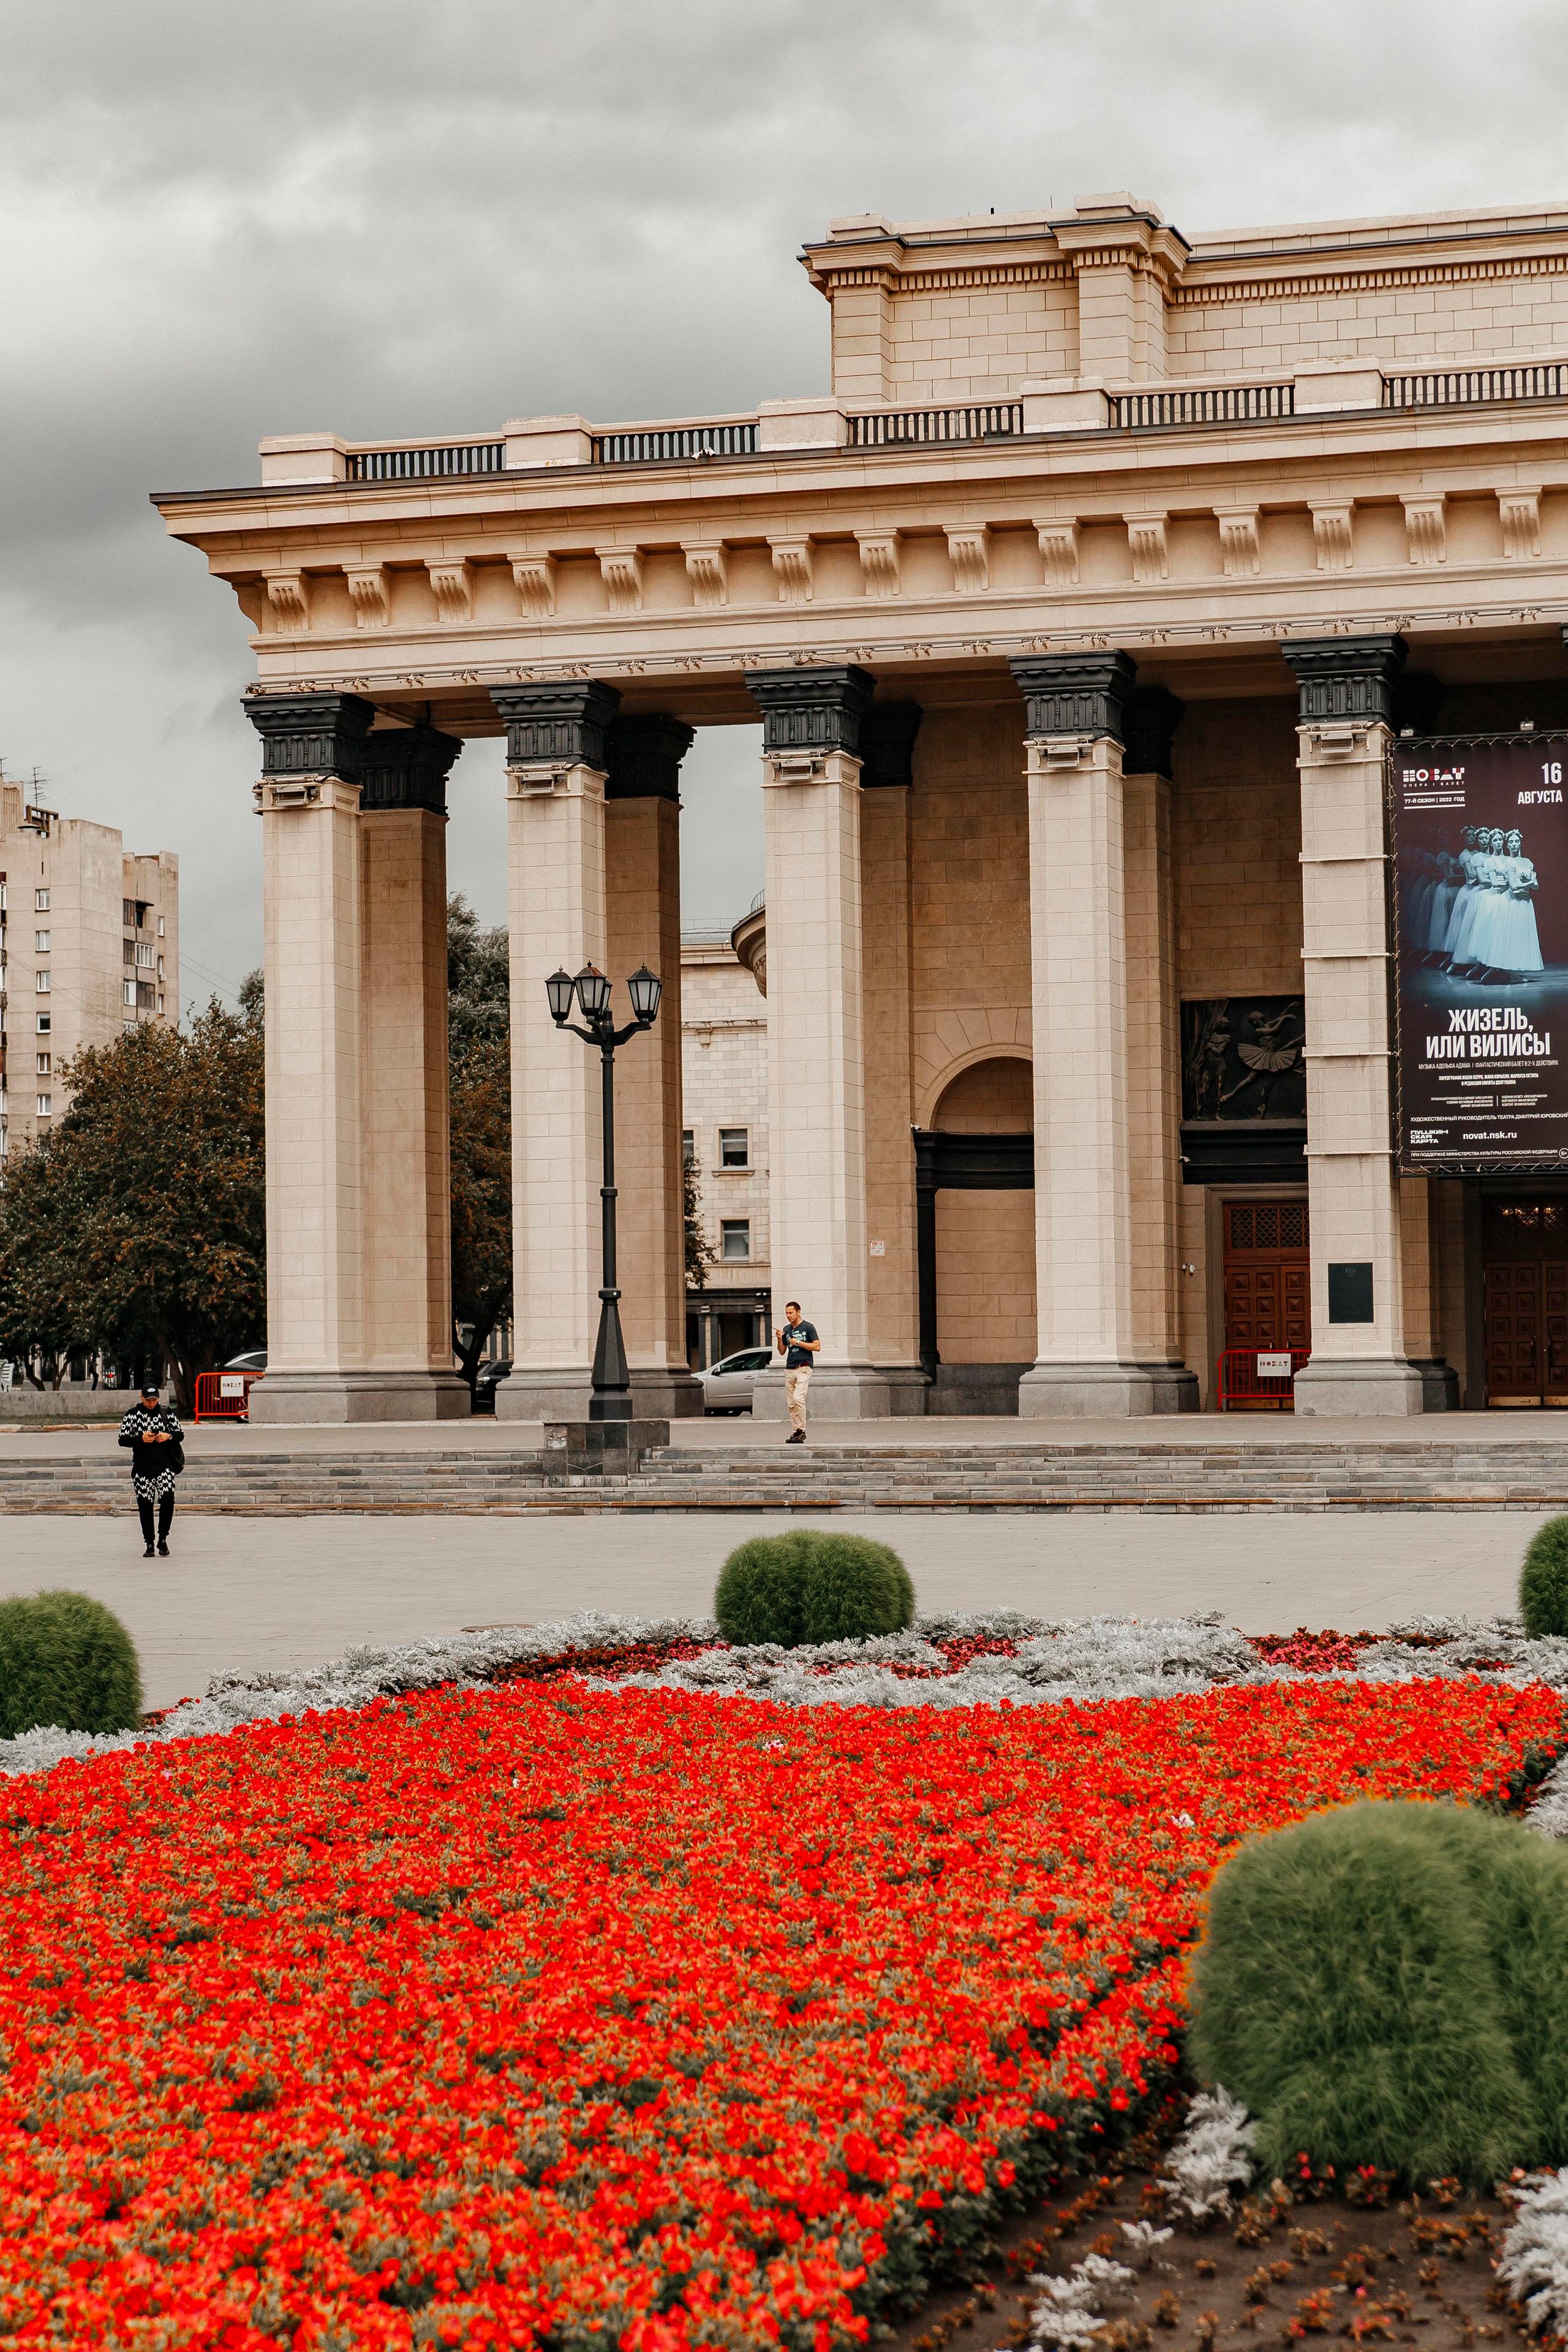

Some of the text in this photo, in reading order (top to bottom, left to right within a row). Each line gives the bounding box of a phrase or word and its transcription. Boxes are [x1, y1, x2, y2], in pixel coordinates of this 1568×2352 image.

[1541, 762, 1562, 785] 16
[1517, 790, 1563, 805] АВГУСТА
[1448, 1007, 1534, 1033] ЖИЗЕЛЬ,
[1426, 1032, 1551, 1059] ИЛИ ВИЛИСЫ
